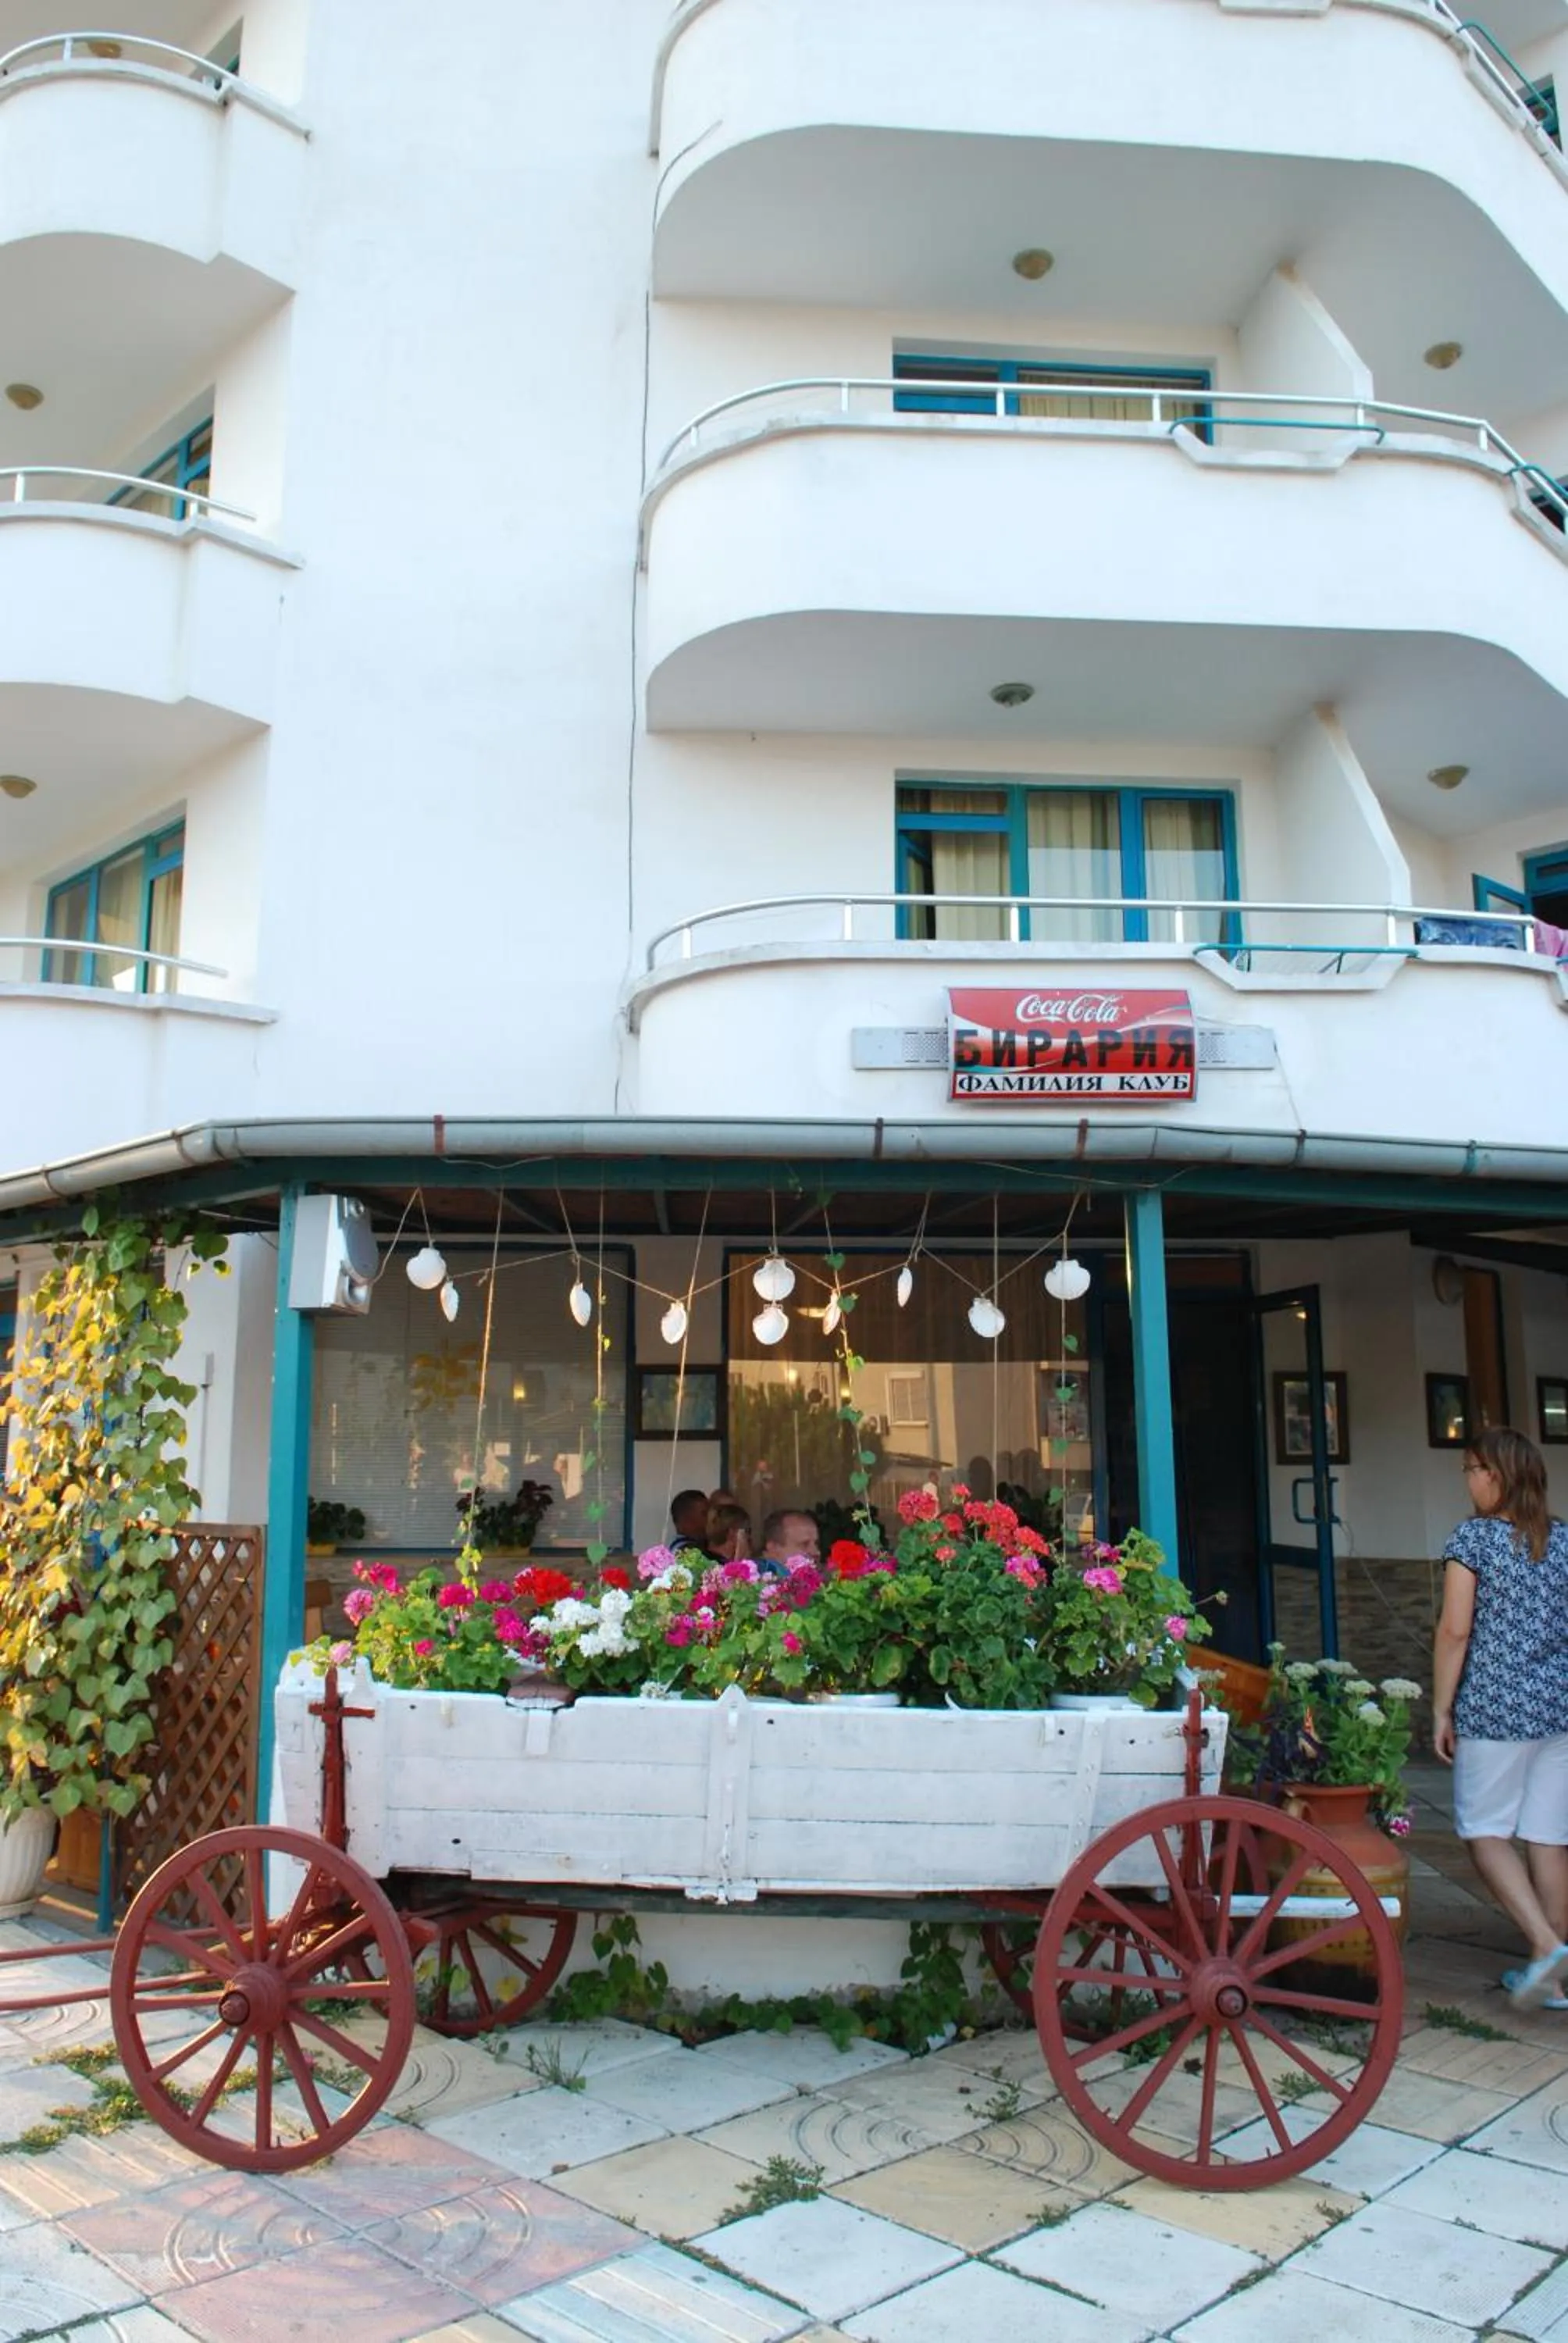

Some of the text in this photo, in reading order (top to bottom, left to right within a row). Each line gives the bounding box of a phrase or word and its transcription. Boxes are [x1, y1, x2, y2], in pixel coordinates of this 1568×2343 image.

[954, 1029, 1193, 1068] БИРАРИЯ
[958, 1075, 1188, 1093] ФАМИЛИЯ КЛУБ
